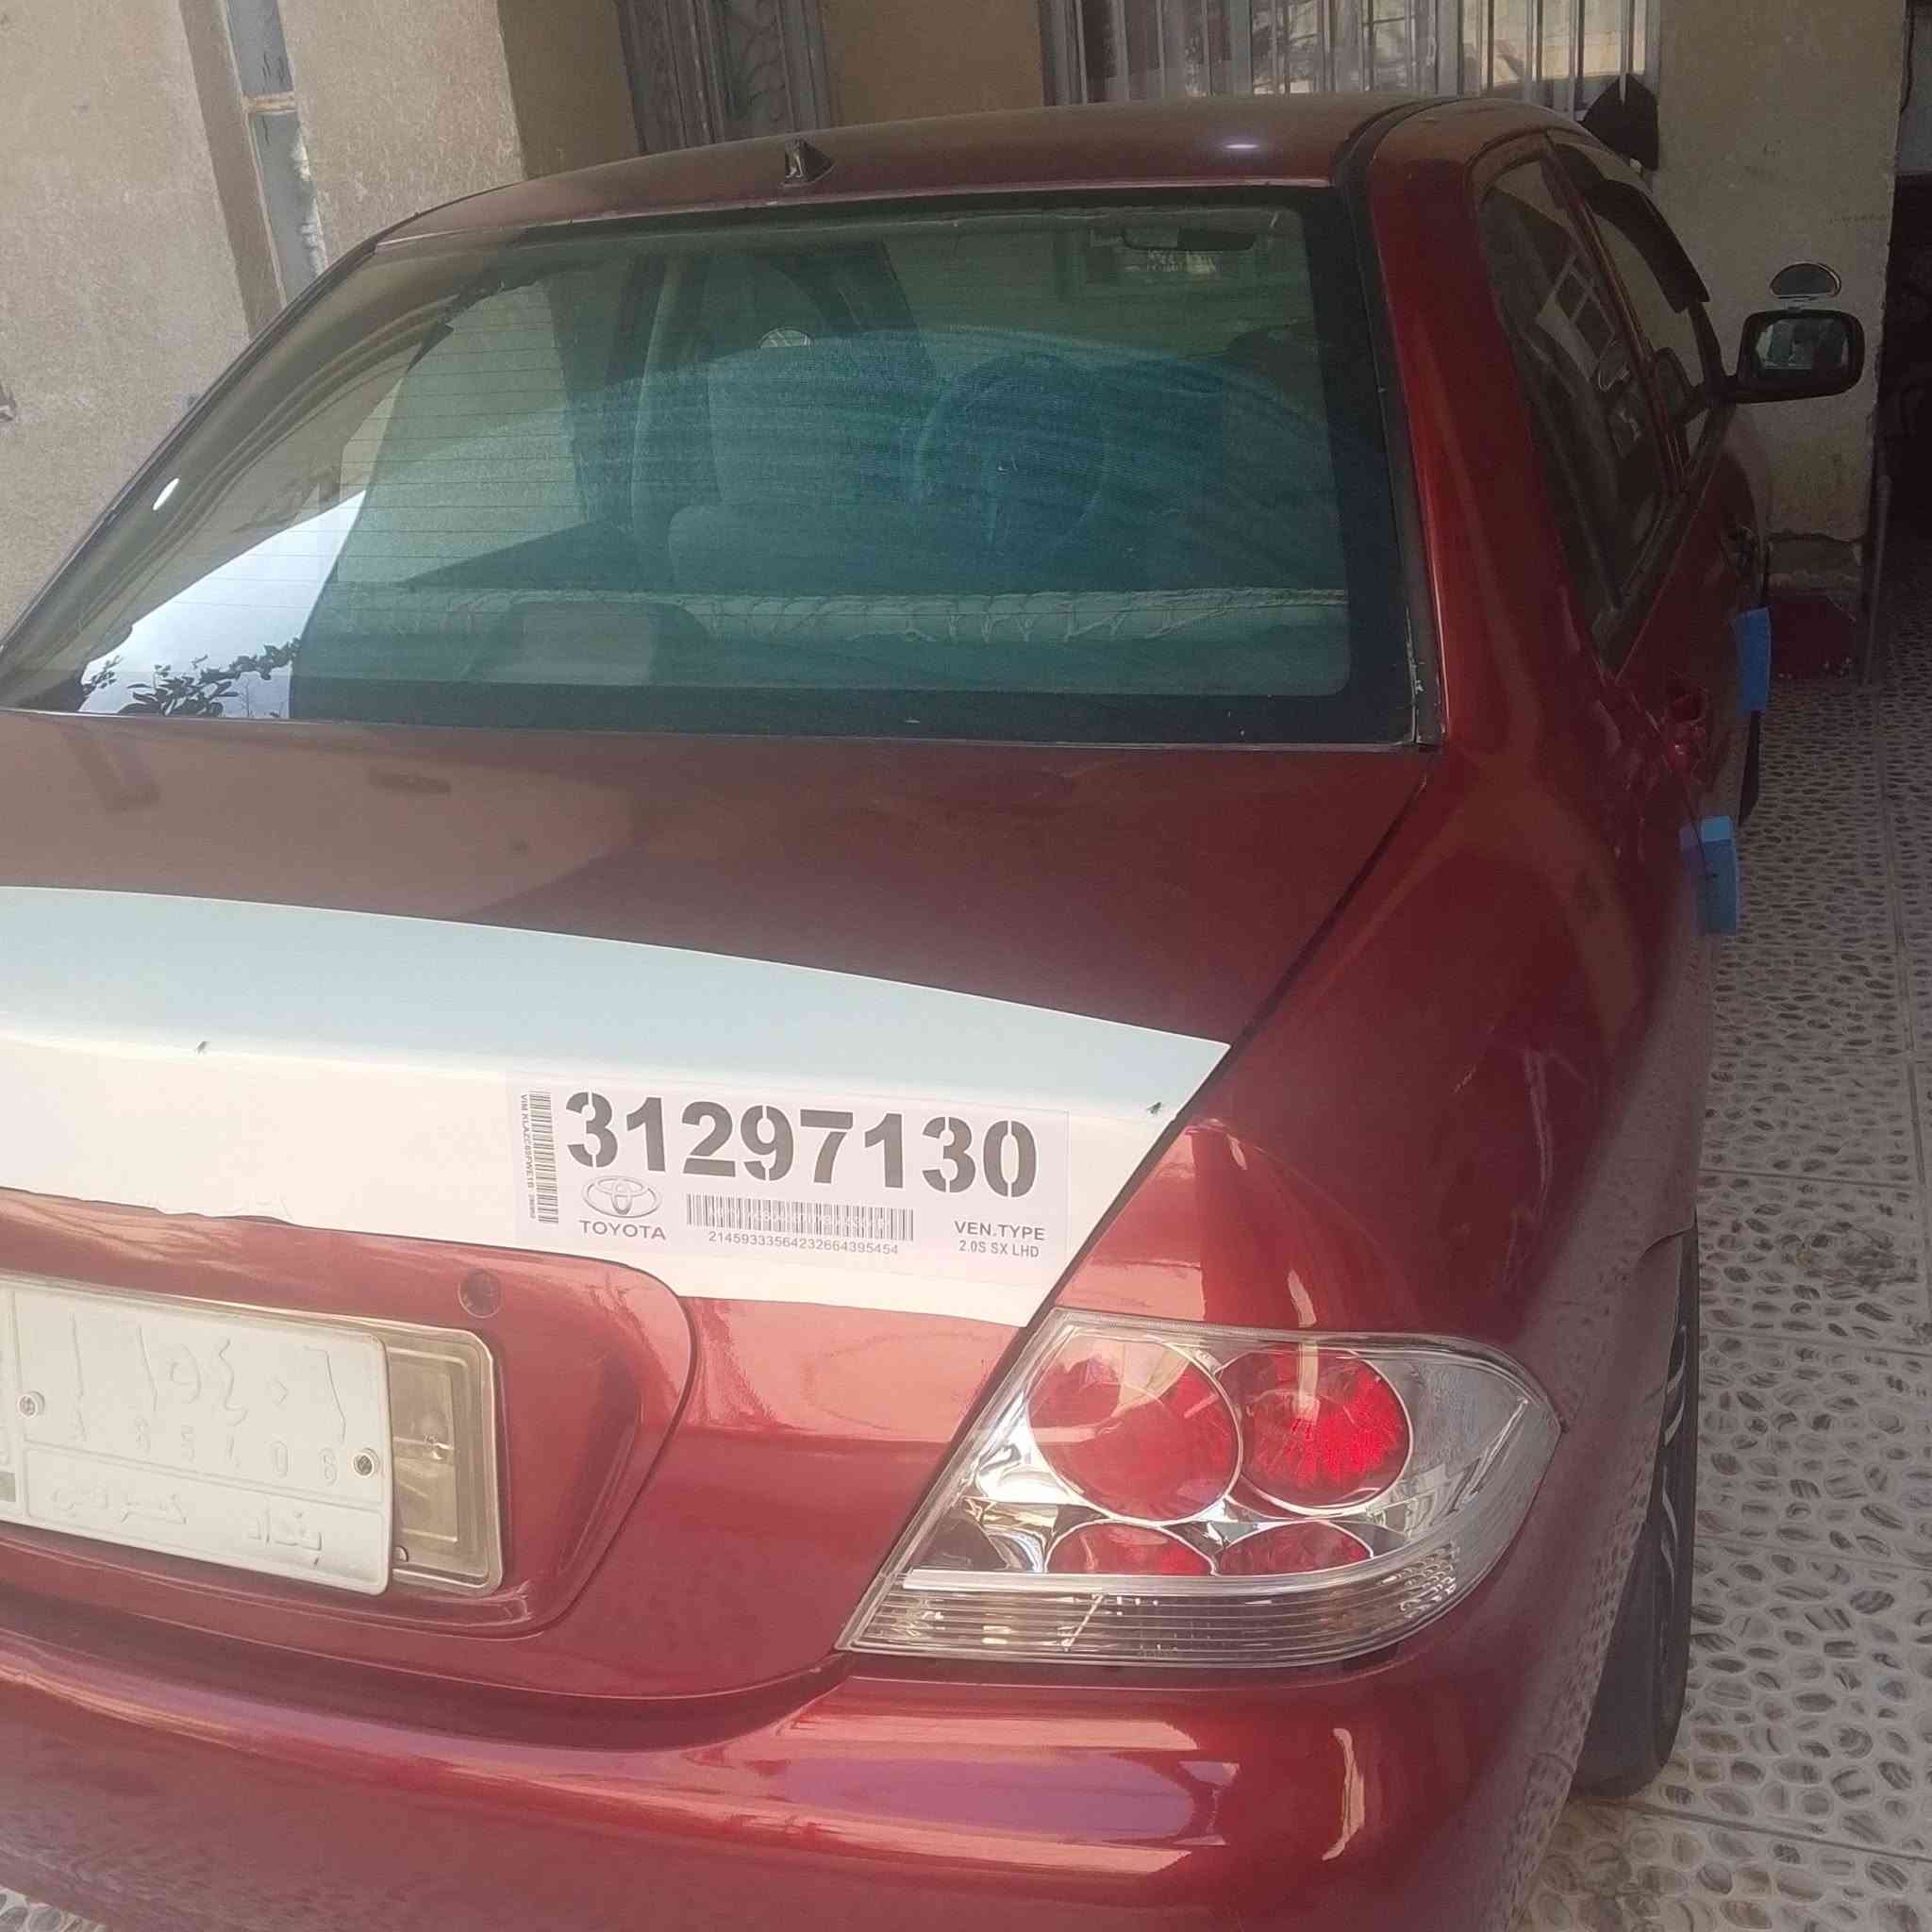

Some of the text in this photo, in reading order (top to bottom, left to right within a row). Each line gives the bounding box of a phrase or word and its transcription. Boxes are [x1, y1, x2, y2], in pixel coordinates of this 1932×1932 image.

[567, 1092, 1037, 1197] 31297130
[578, 1220, 666, 1241] TOYOTA
[954, 1220, 1045, 1241] VEN.TYPE
[958, 1240, 1040, 1257] 2.0S SX LHD
